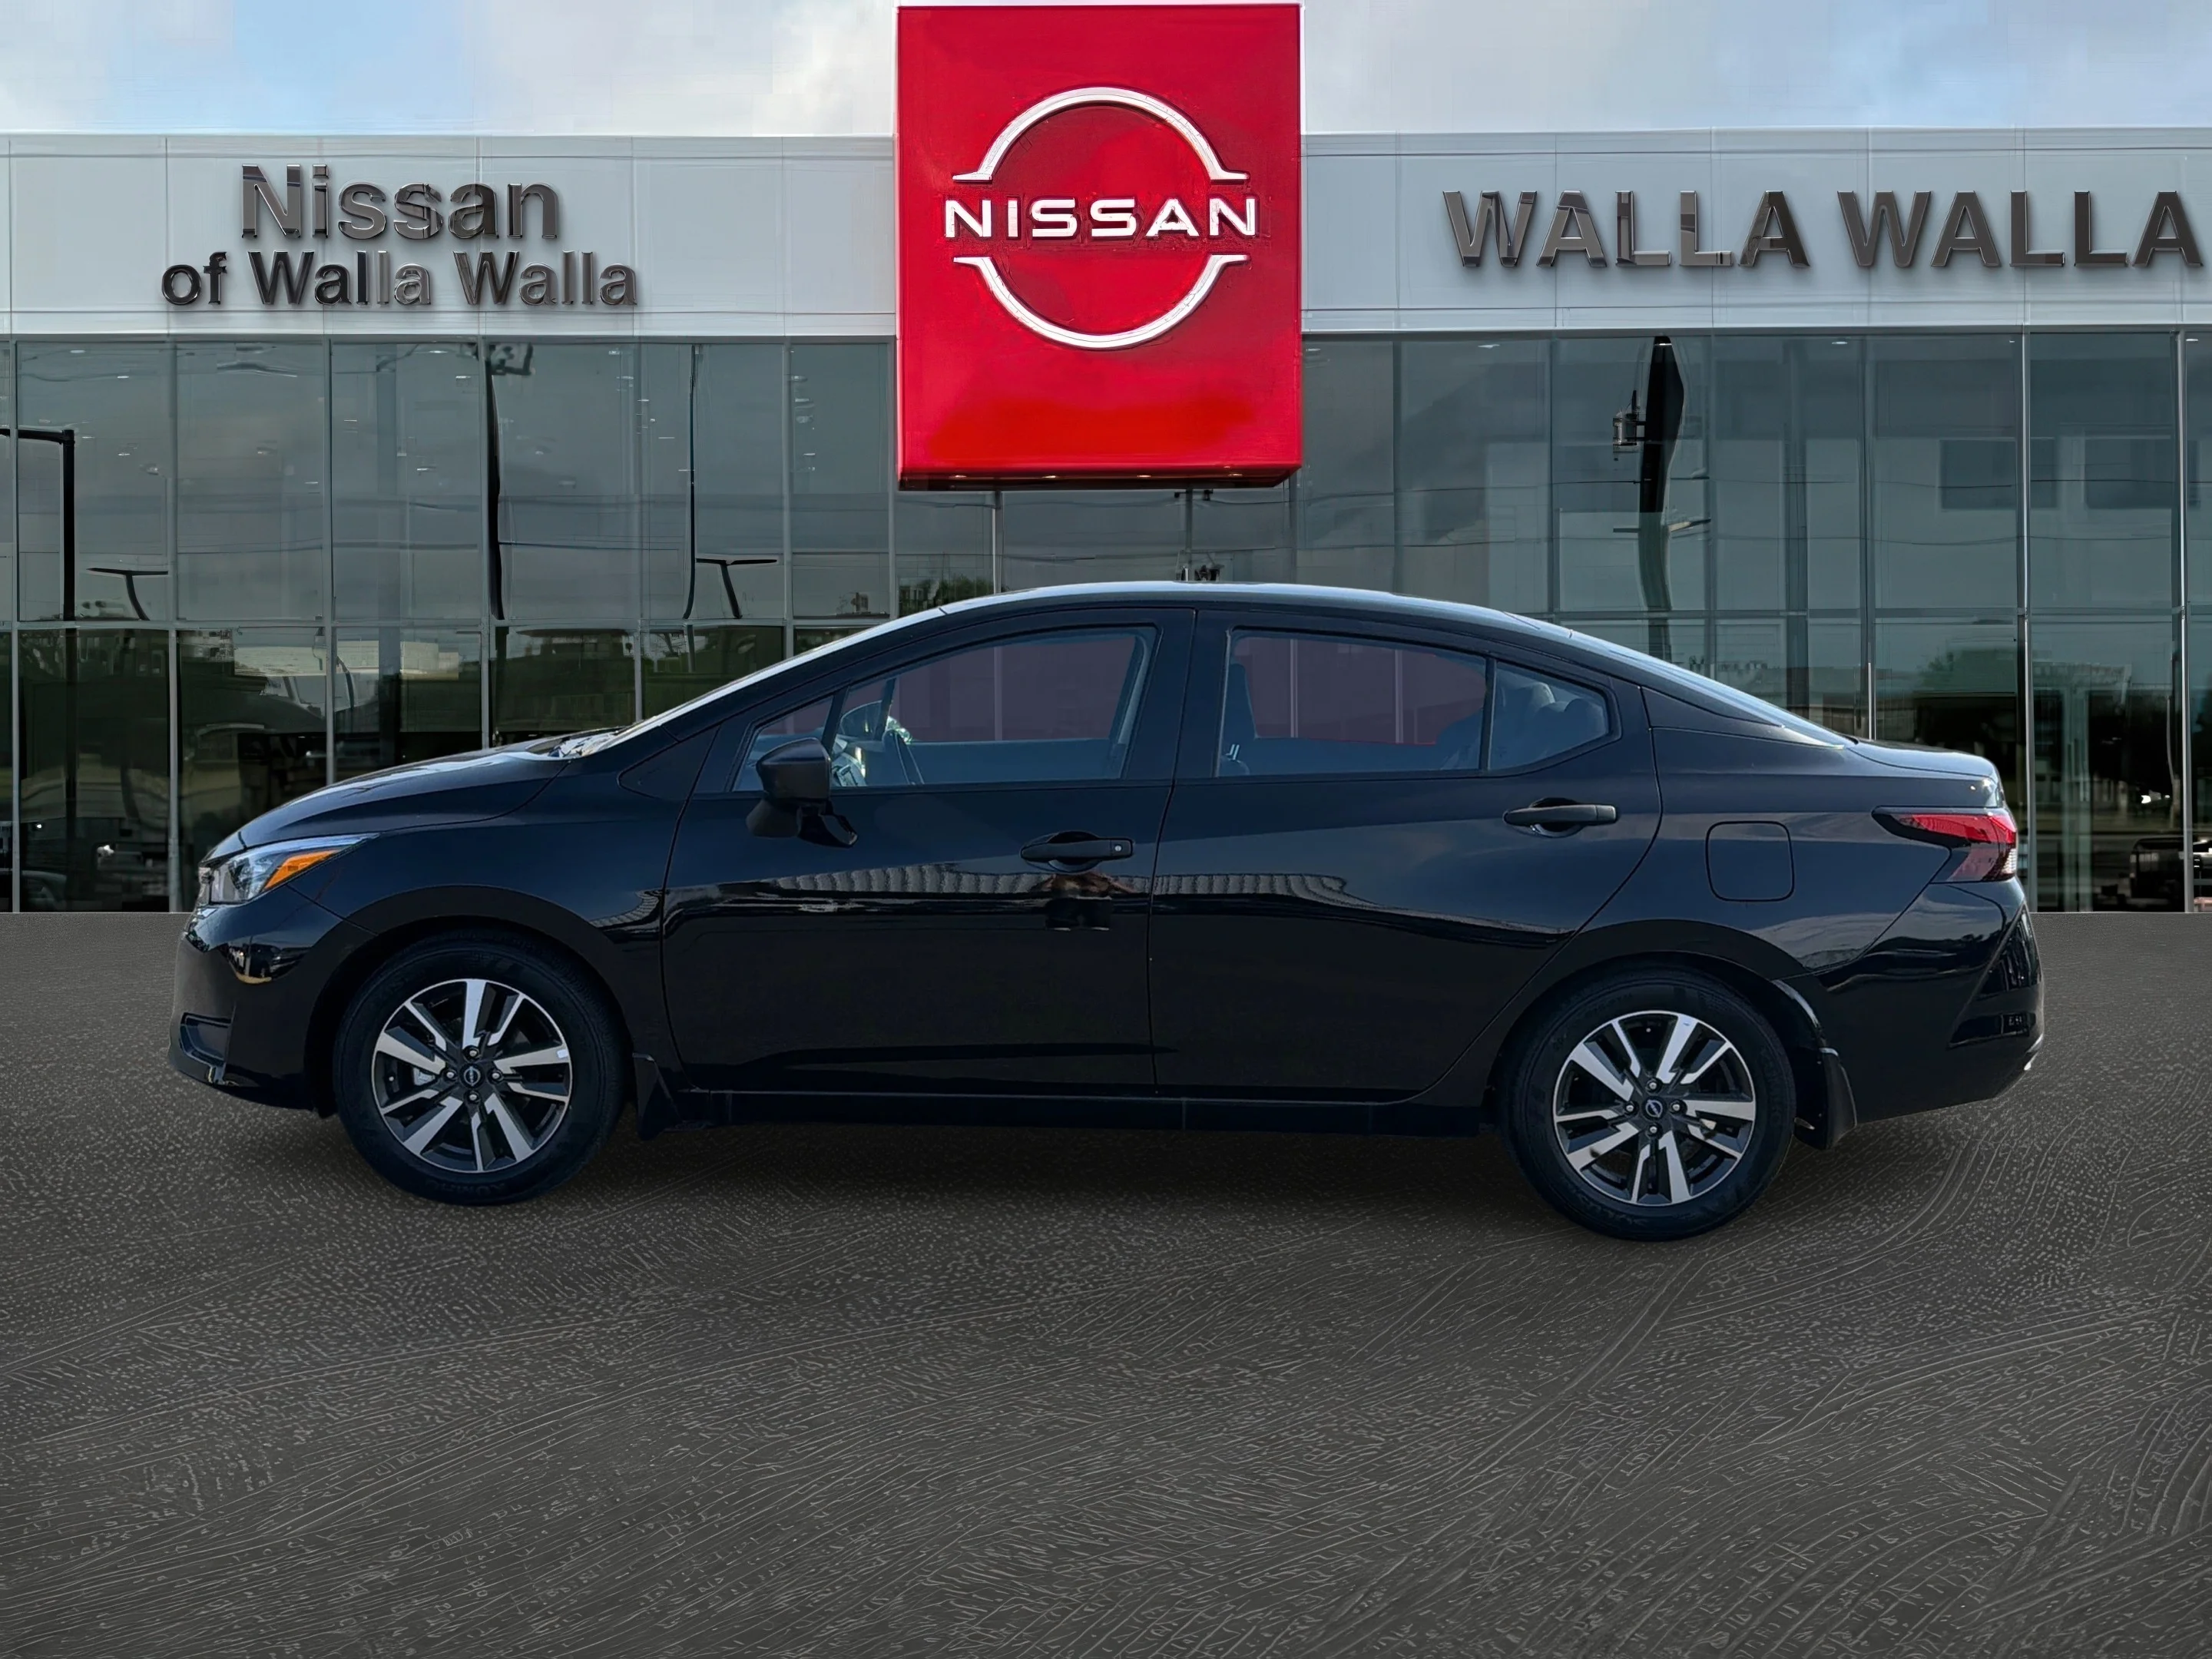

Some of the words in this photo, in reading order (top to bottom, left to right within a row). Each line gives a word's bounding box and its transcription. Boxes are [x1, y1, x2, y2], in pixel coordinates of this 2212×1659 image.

[241, 163, 559, 240] Nissan
[944, 197, 1257, 239] NISSAN
[1442, 189, 1810, 267] WALLA
[1837, 190, 2203, 267] WALLA
[161, 251, 227, 306] of
[247, 250, 430, 306] Walla
[452, 250, 637, 306] Walla
